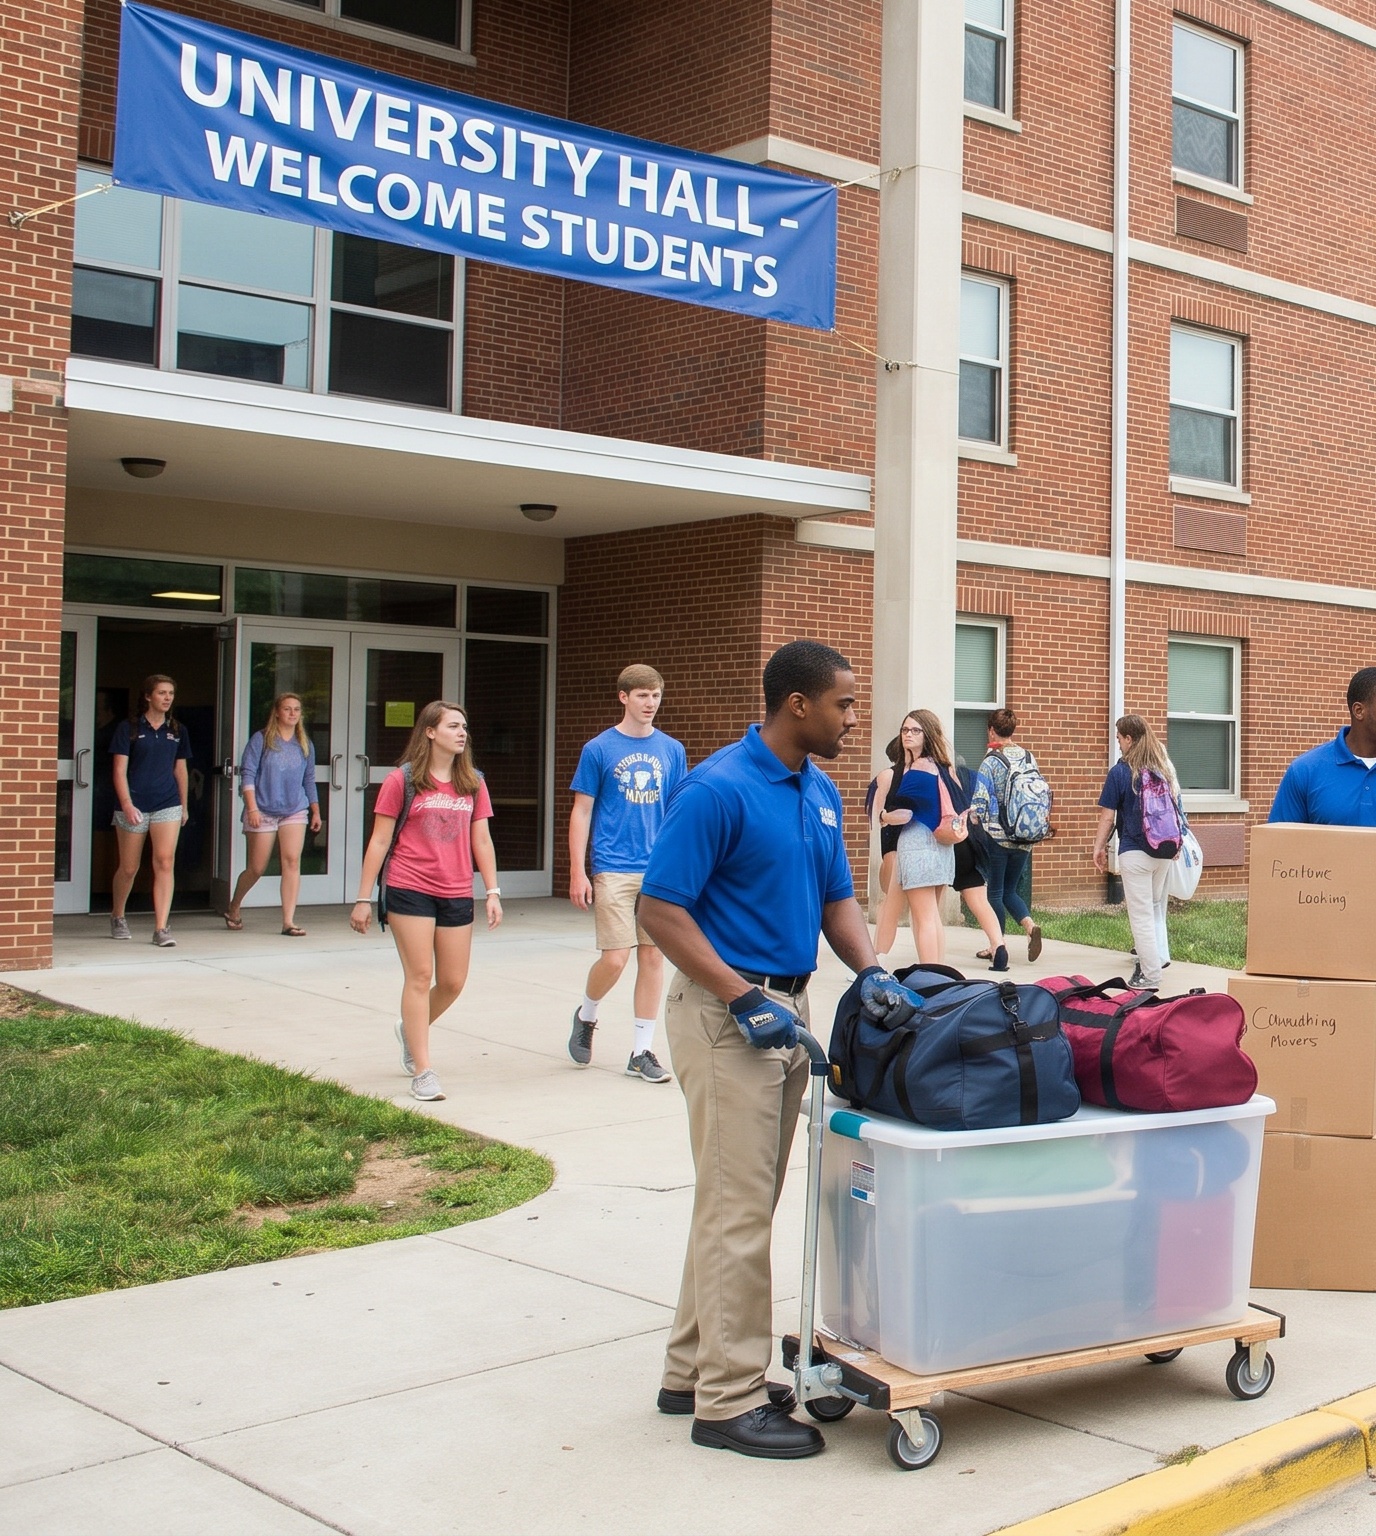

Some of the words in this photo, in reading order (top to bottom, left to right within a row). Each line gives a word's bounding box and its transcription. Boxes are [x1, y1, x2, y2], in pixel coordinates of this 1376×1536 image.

[180, 43, 603, 197] UNIVERSITY
[618, 154, 765, 238] HALL
[204, 130, 506, 242] WELCOME
[521, 204, 779, 299] STUDENTS
[1270, 1034, 1319, 1048] Movers
